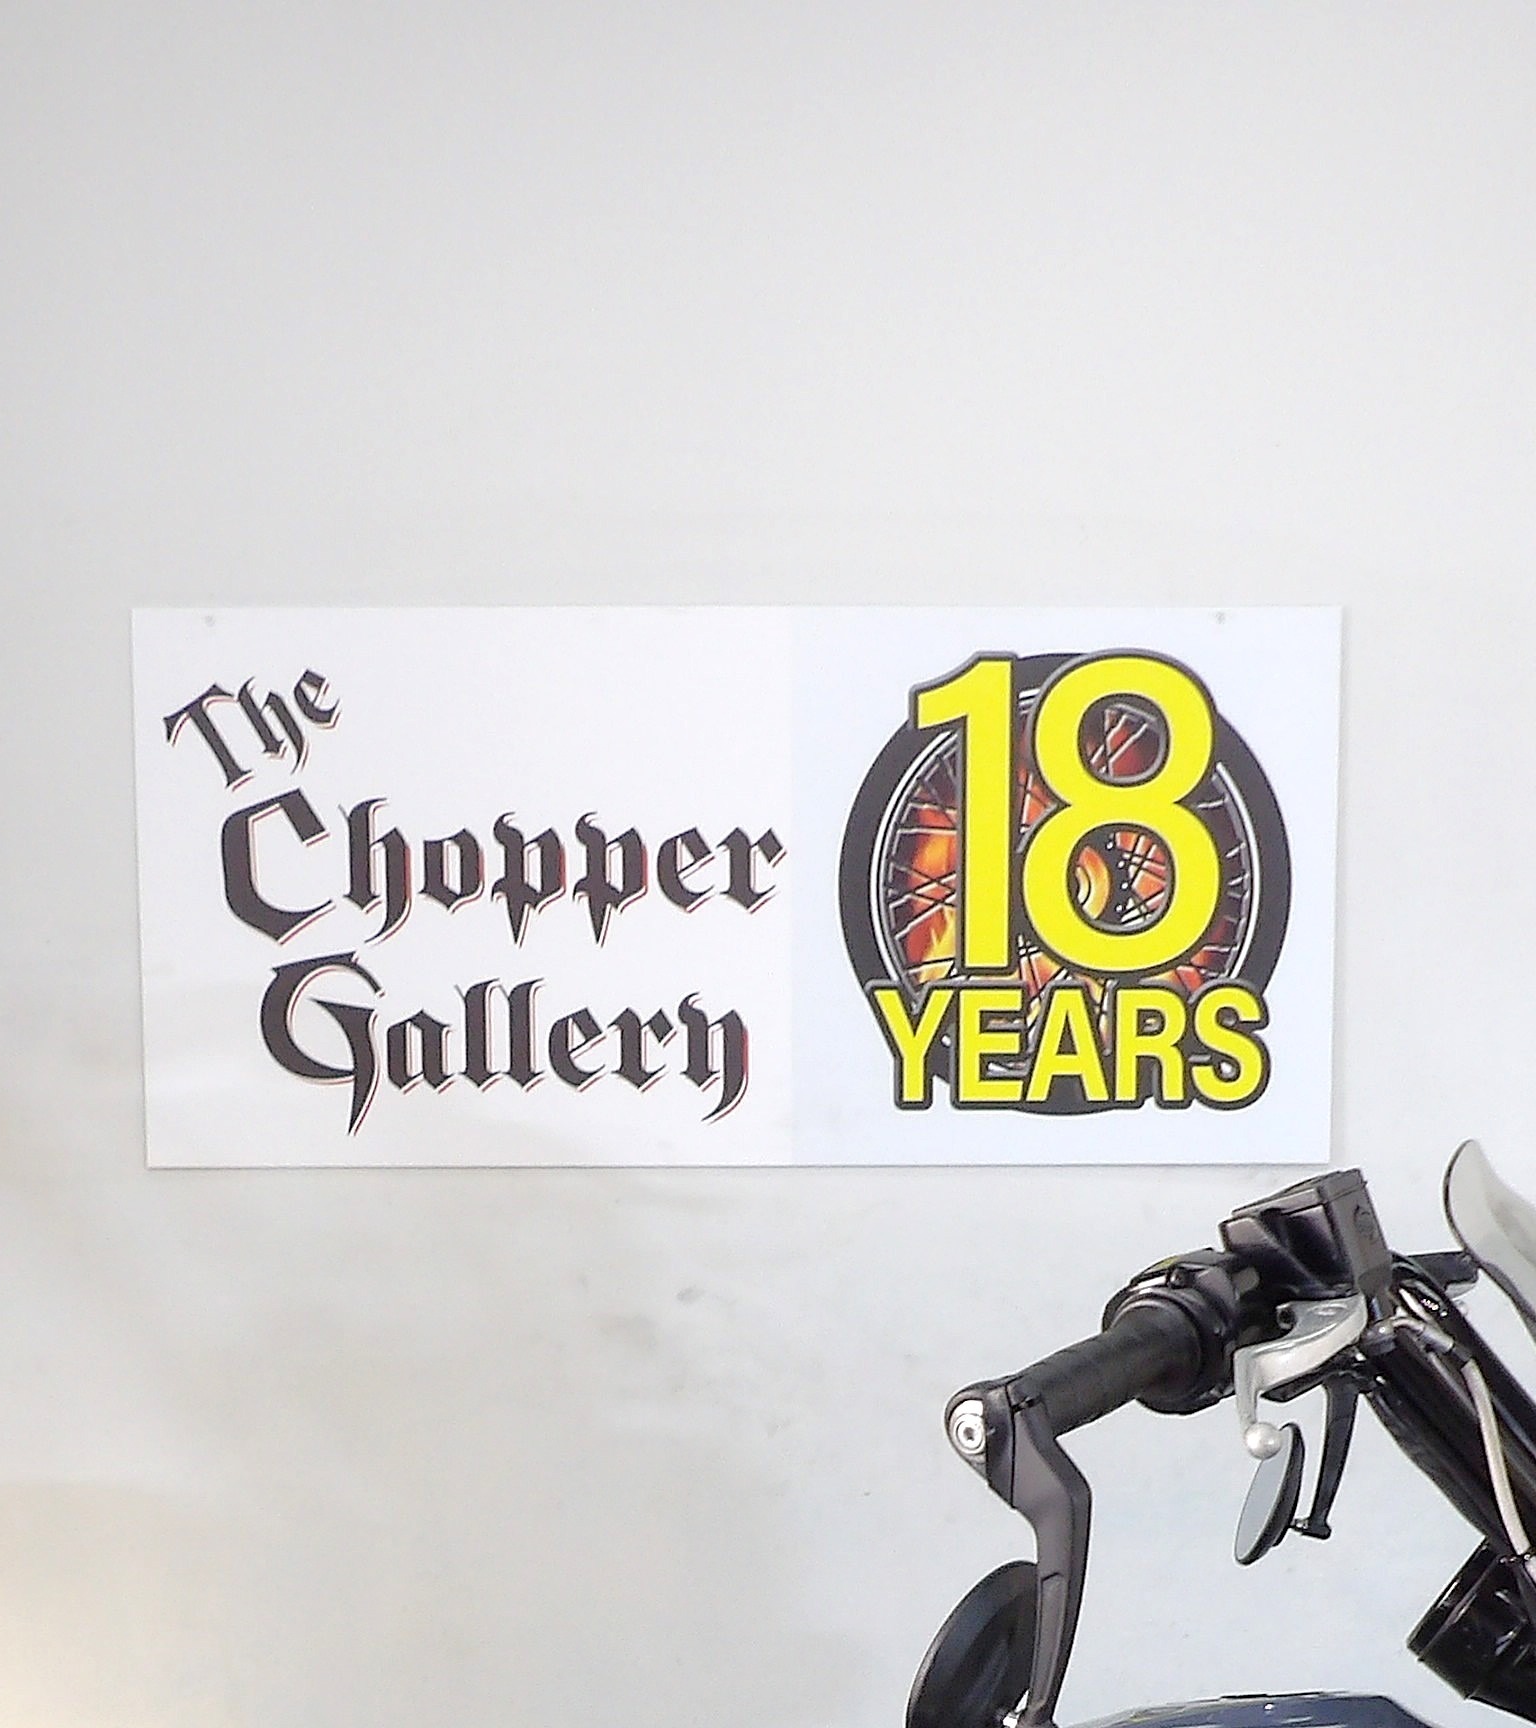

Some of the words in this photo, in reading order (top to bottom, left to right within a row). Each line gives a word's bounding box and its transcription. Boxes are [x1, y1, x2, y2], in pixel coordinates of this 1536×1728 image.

[163, 669, 342, 793] The
[908, 647, 1222, 974] 18
[220, 787, 789, 948] Chopper
[260, 951, 750, 1136] Gallery
[868, 980, 1268, 1110] YEARS
